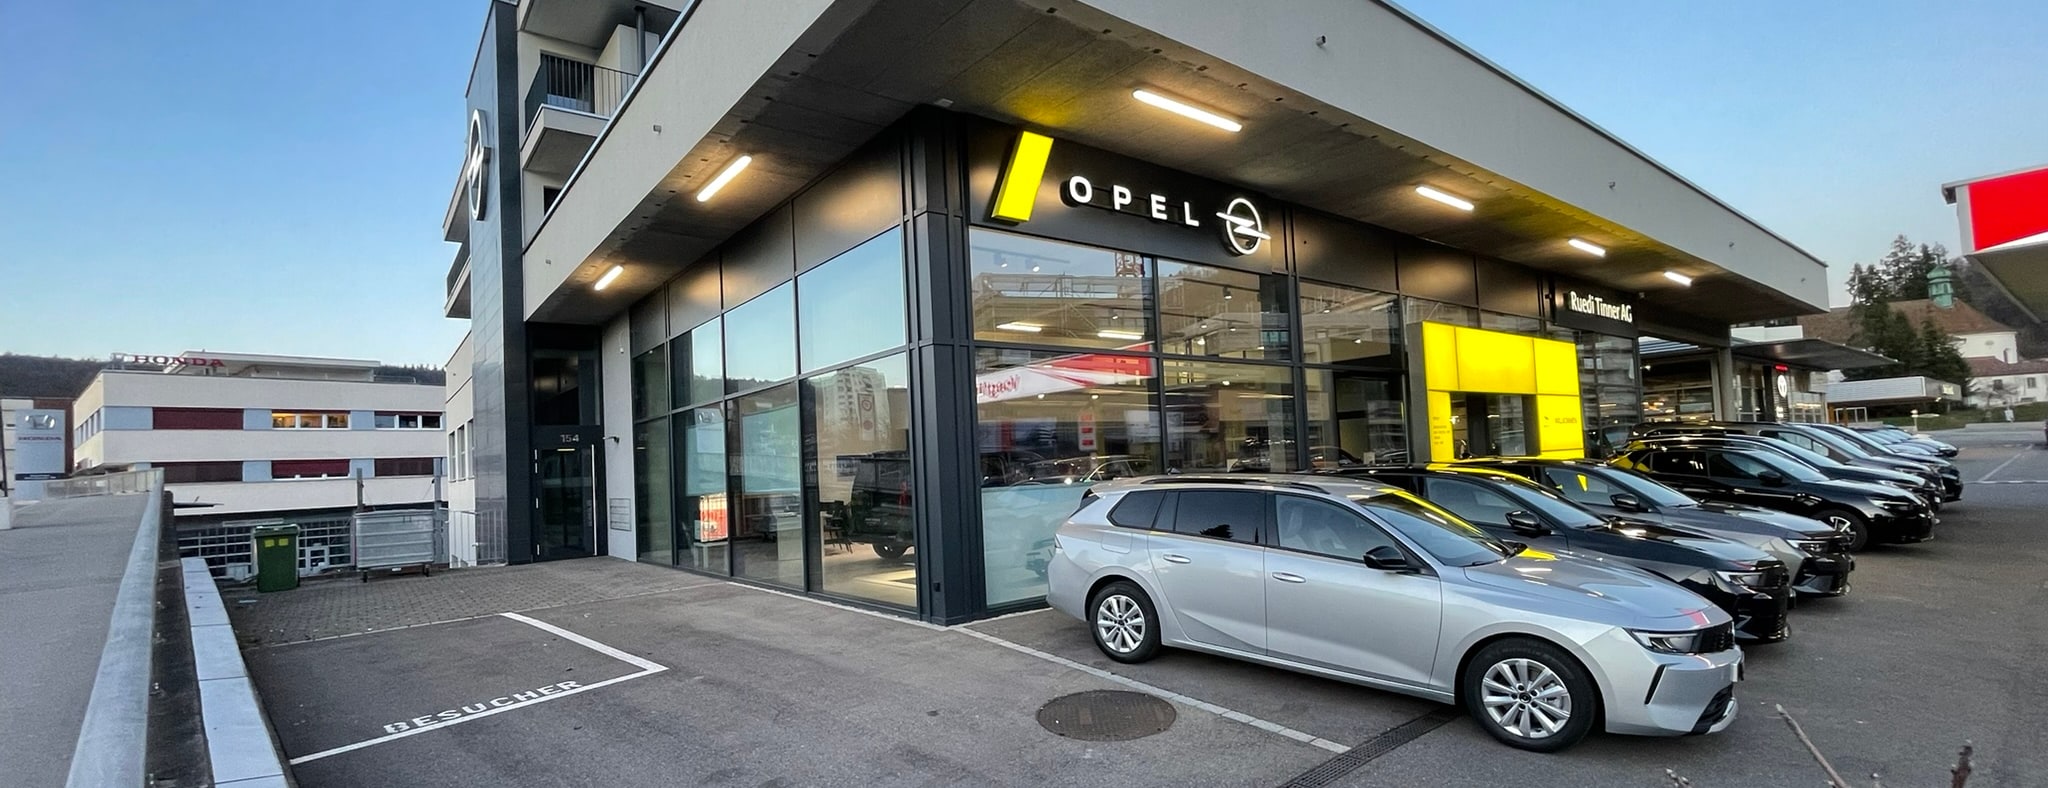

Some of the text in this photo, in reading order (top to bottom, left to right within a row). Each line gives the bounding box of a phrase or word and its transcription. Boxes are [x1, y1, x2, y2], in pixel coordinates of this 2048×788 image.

[1069, 175, 1200, 227] OPEL
[1570, 291, 1633, 323] Ruedi Tinner AG
[133, 355, 225, 367] HONDA
[560, 434, 579, 443] 154
[384, 680, 583, 733] BESUCHER
